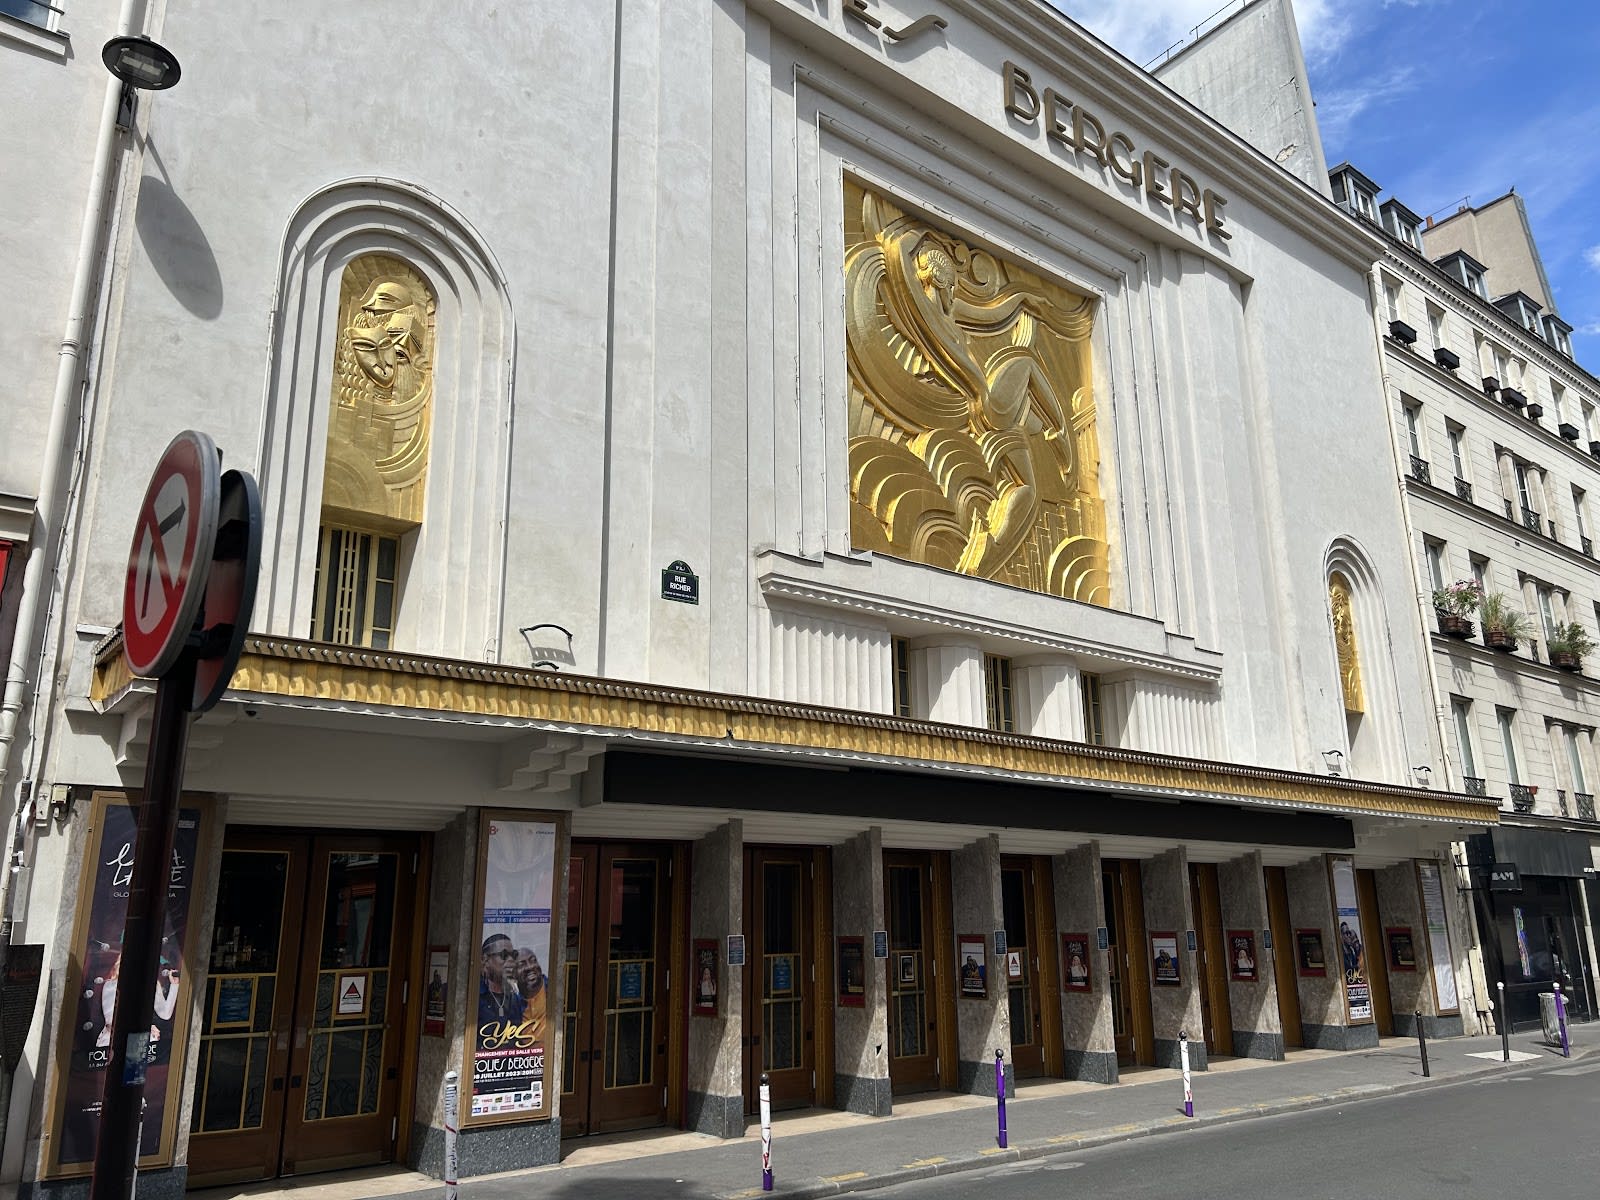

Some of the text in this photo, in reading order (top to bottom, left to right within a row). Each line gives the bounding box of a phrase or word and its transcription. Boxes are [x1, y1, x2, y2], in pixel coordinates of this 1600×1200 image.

[1003, 60, 1233, 241] BERGERE
[670, 583, 692, 592] RICHER
[508, 1055, 545, 1070] BERGERE
